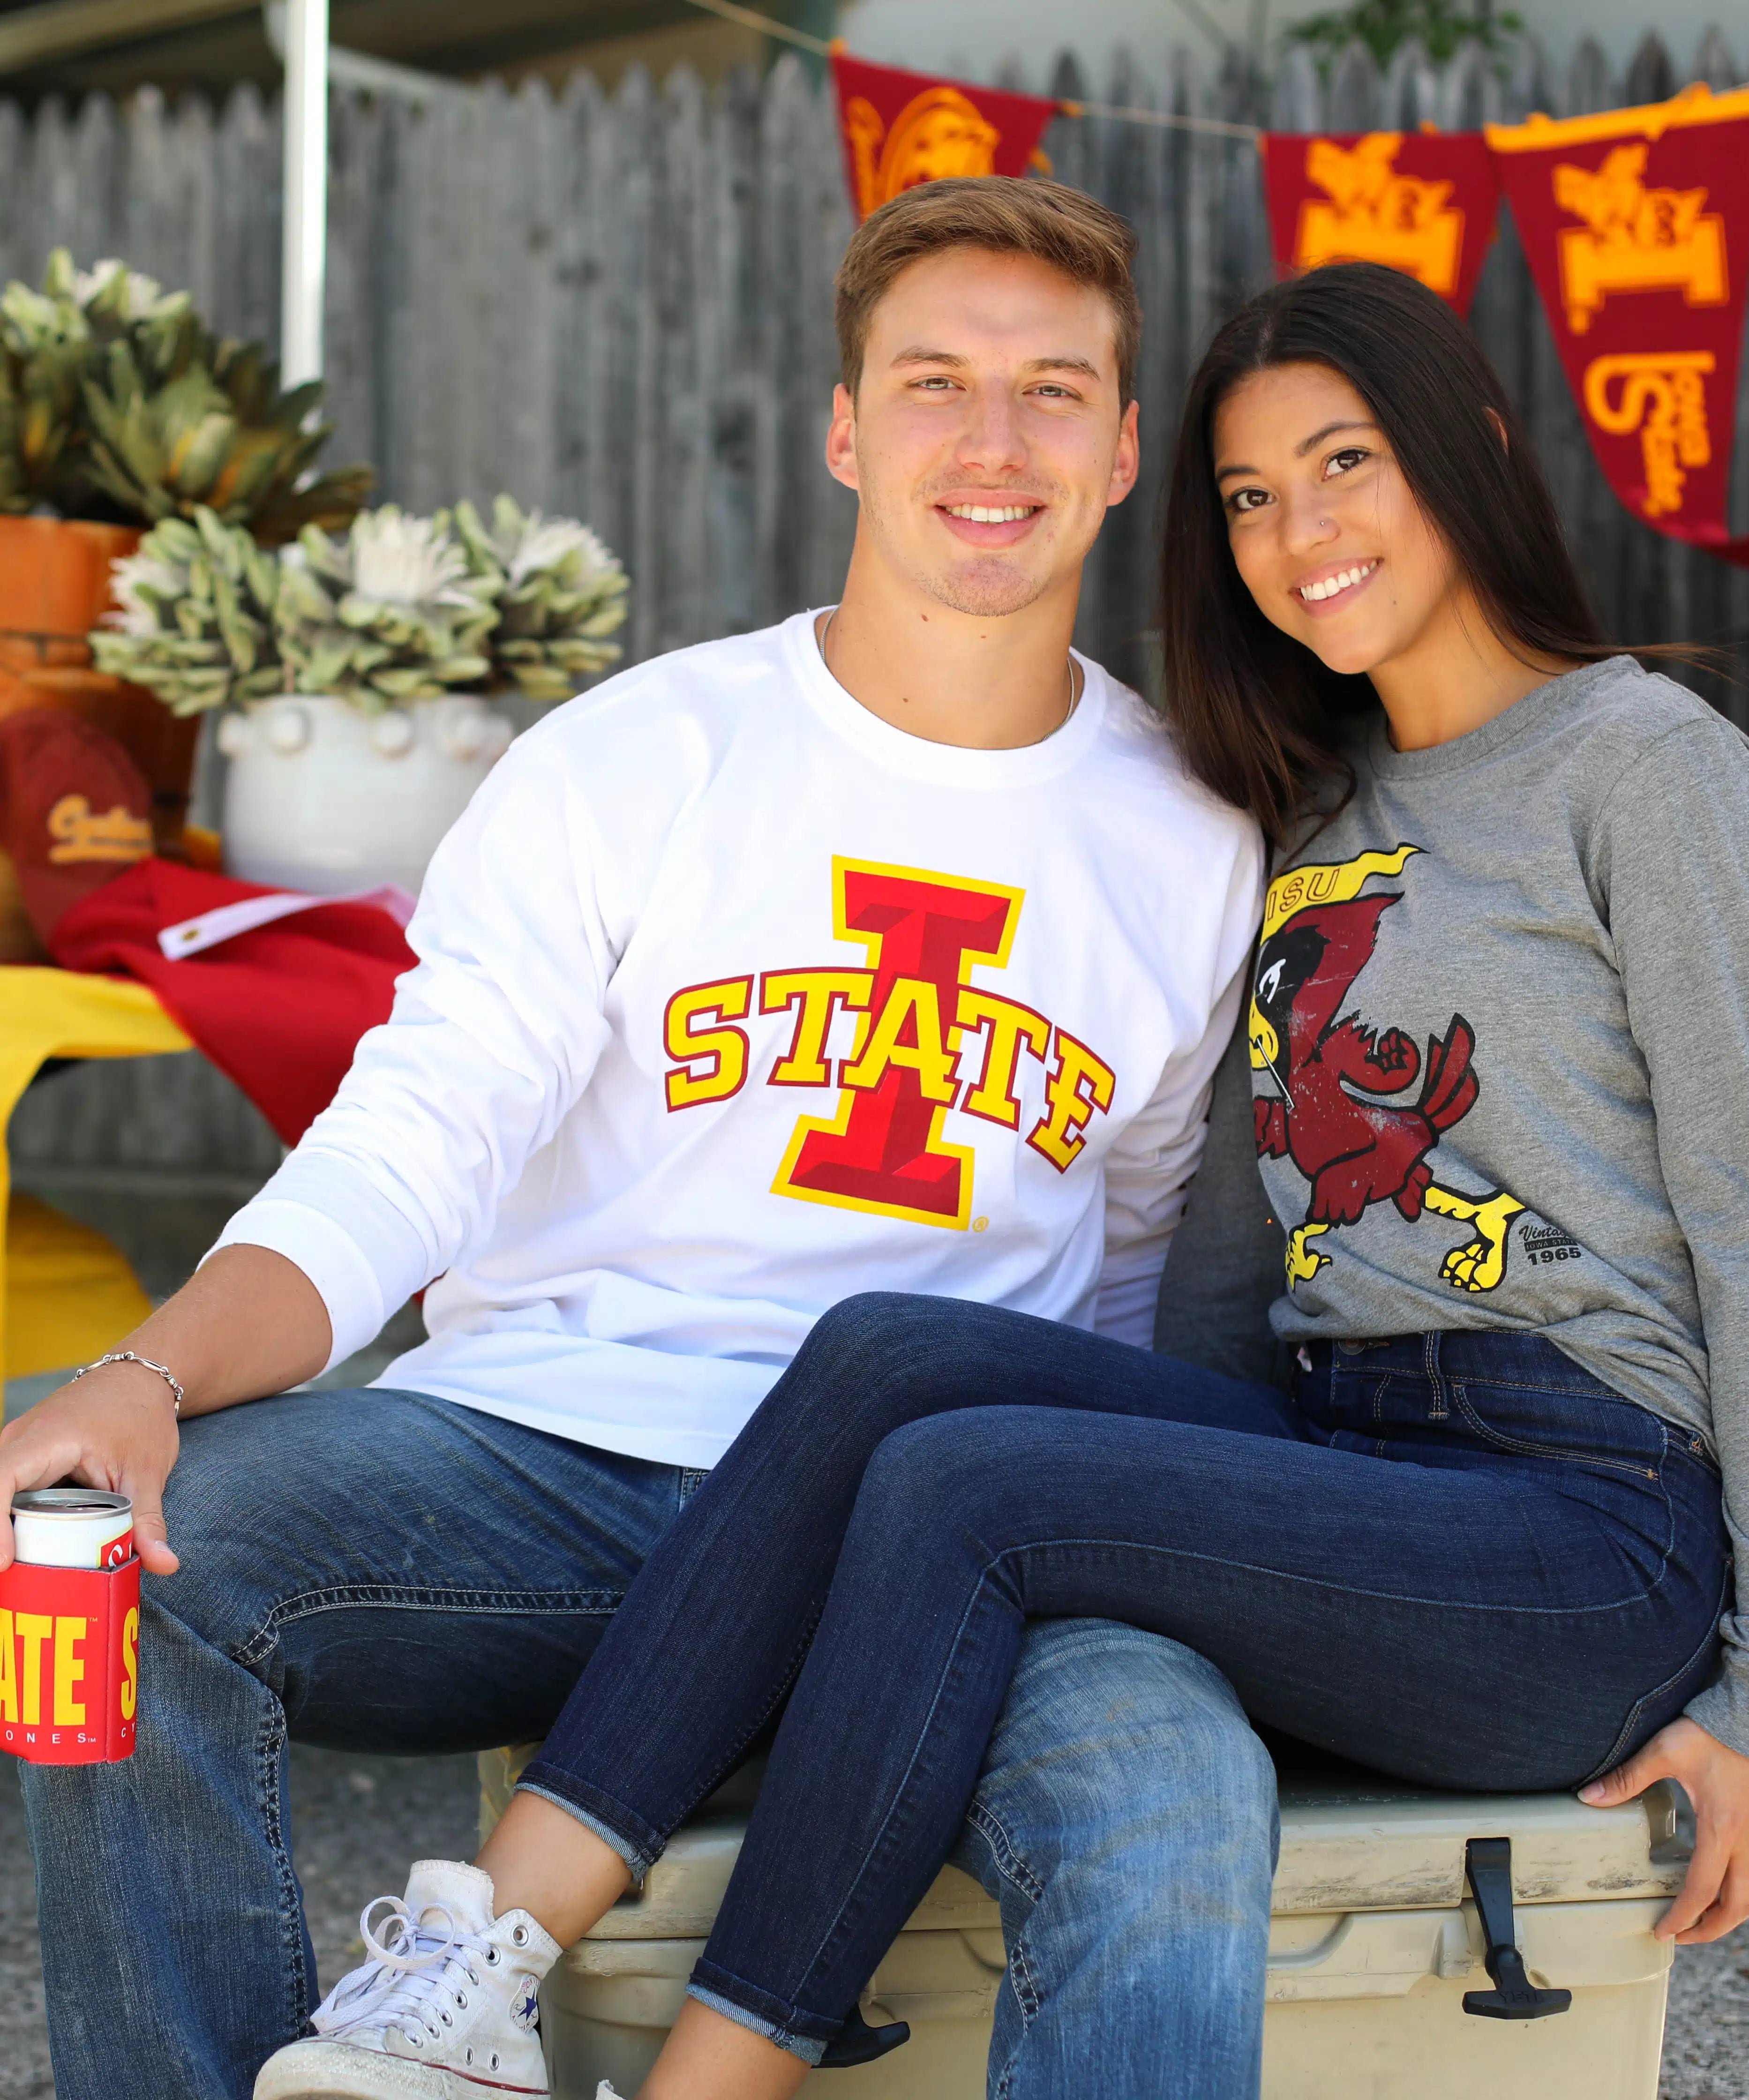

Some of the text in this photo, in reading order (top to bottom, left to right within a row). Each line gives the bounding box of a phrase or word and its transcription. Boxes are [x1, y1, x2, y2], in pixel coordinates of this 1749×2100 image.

[1267, 868, 1340, 922] ISU
[663, 966, 1116, 1174] STATE
[1518, 1224, 1569, 1242] Vinta
[1526, 1241, 1548, 1249] IOWA
[1527, 1247, 1581, 1266] 1965
